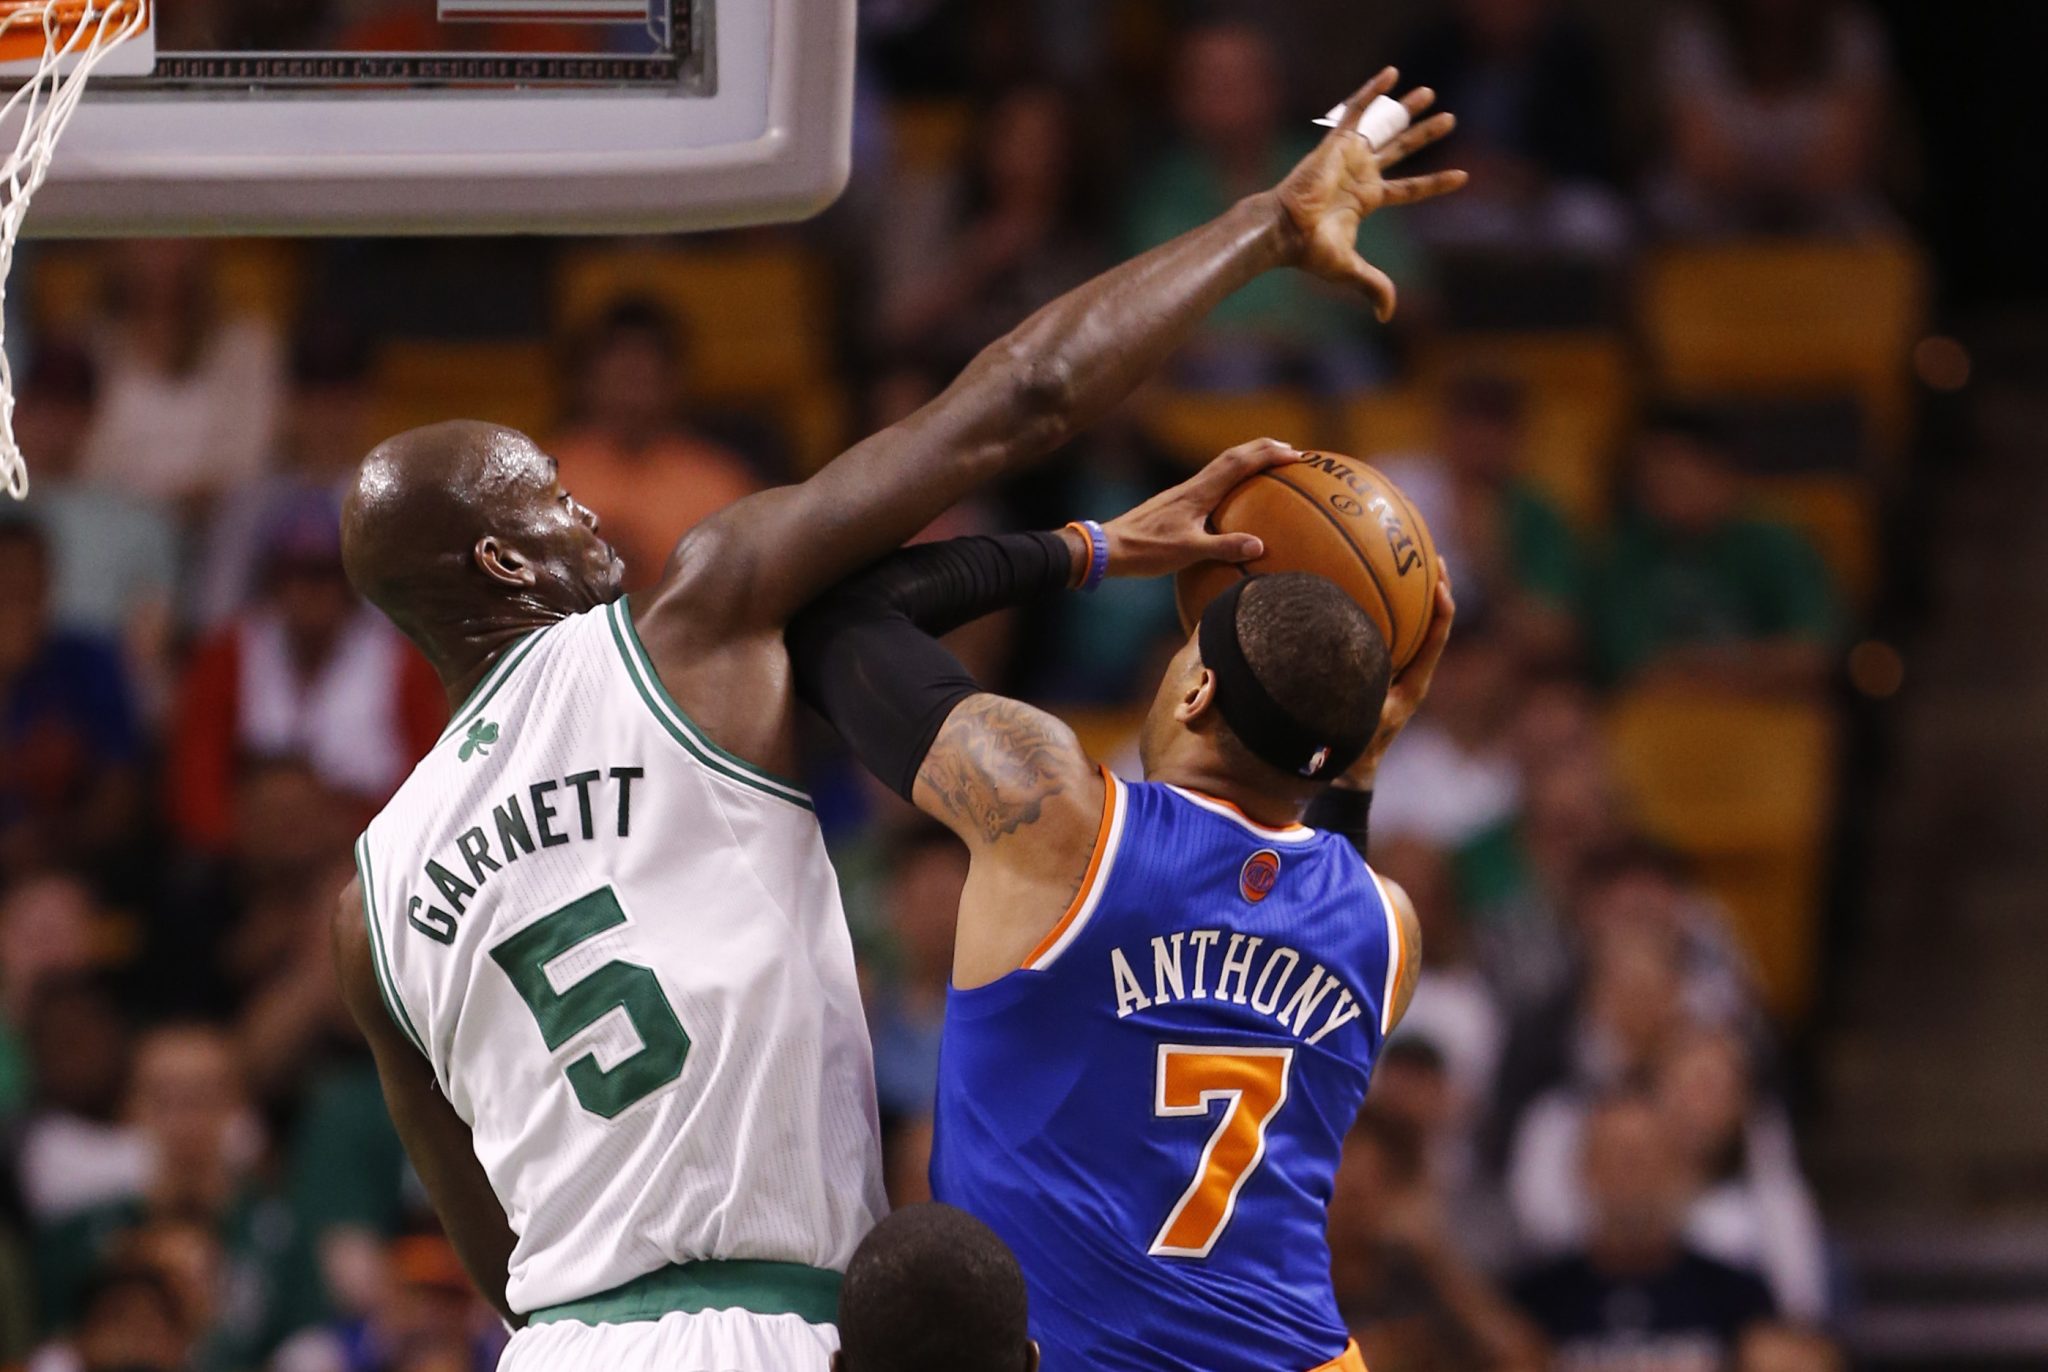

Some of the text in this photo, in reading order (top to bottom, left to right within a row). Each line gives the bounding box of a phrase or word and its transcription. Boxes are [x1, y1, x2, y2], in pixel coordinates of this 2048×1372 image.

[1301, 451, 1422, 577] SPALDING
[407, 766, 644, 946] GARNETT
[488, 883, 691, 1120] 5
[1111, 929, 1361, 1045] ANTHONY
[1148, 1043, 1294, 1258] 7
